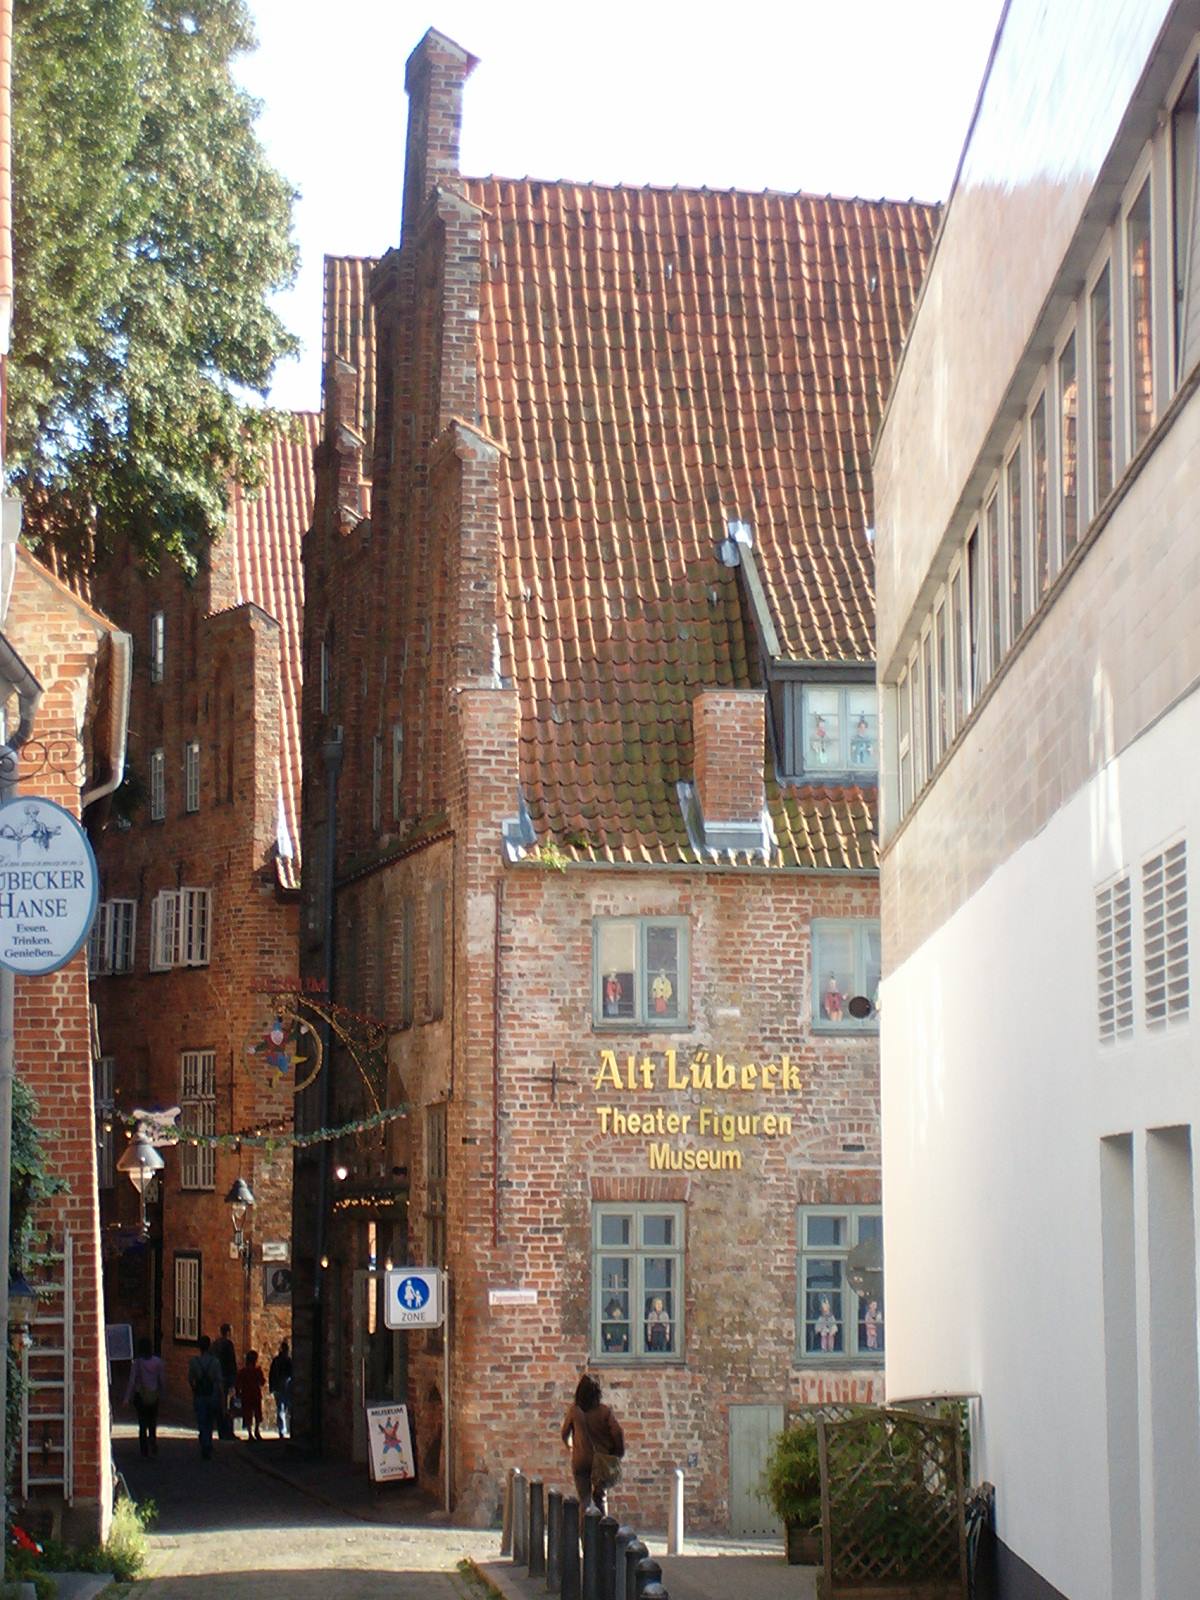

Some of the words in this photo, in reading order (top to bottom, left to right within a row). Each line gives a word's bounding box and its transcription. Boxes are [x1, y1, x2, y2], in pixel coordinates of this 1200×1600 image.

[0, 892, 68, 919] HANSE
[16, 923, 48, 933] Essen.
[12, 936, 52, 945] Trinken.
[592, 1050, 656, 1091] Alt
[665, 1050, 803, 1091] Lübeck
[597, 1107, 692, 1135] Theater
[700, 1108, 792, 1142] Figuren
[650, 1143, 742, 1170] Museum
[401, 1312, 426, 1322] ZONE
[371, 1407, 404, 1417] MUSEUM
